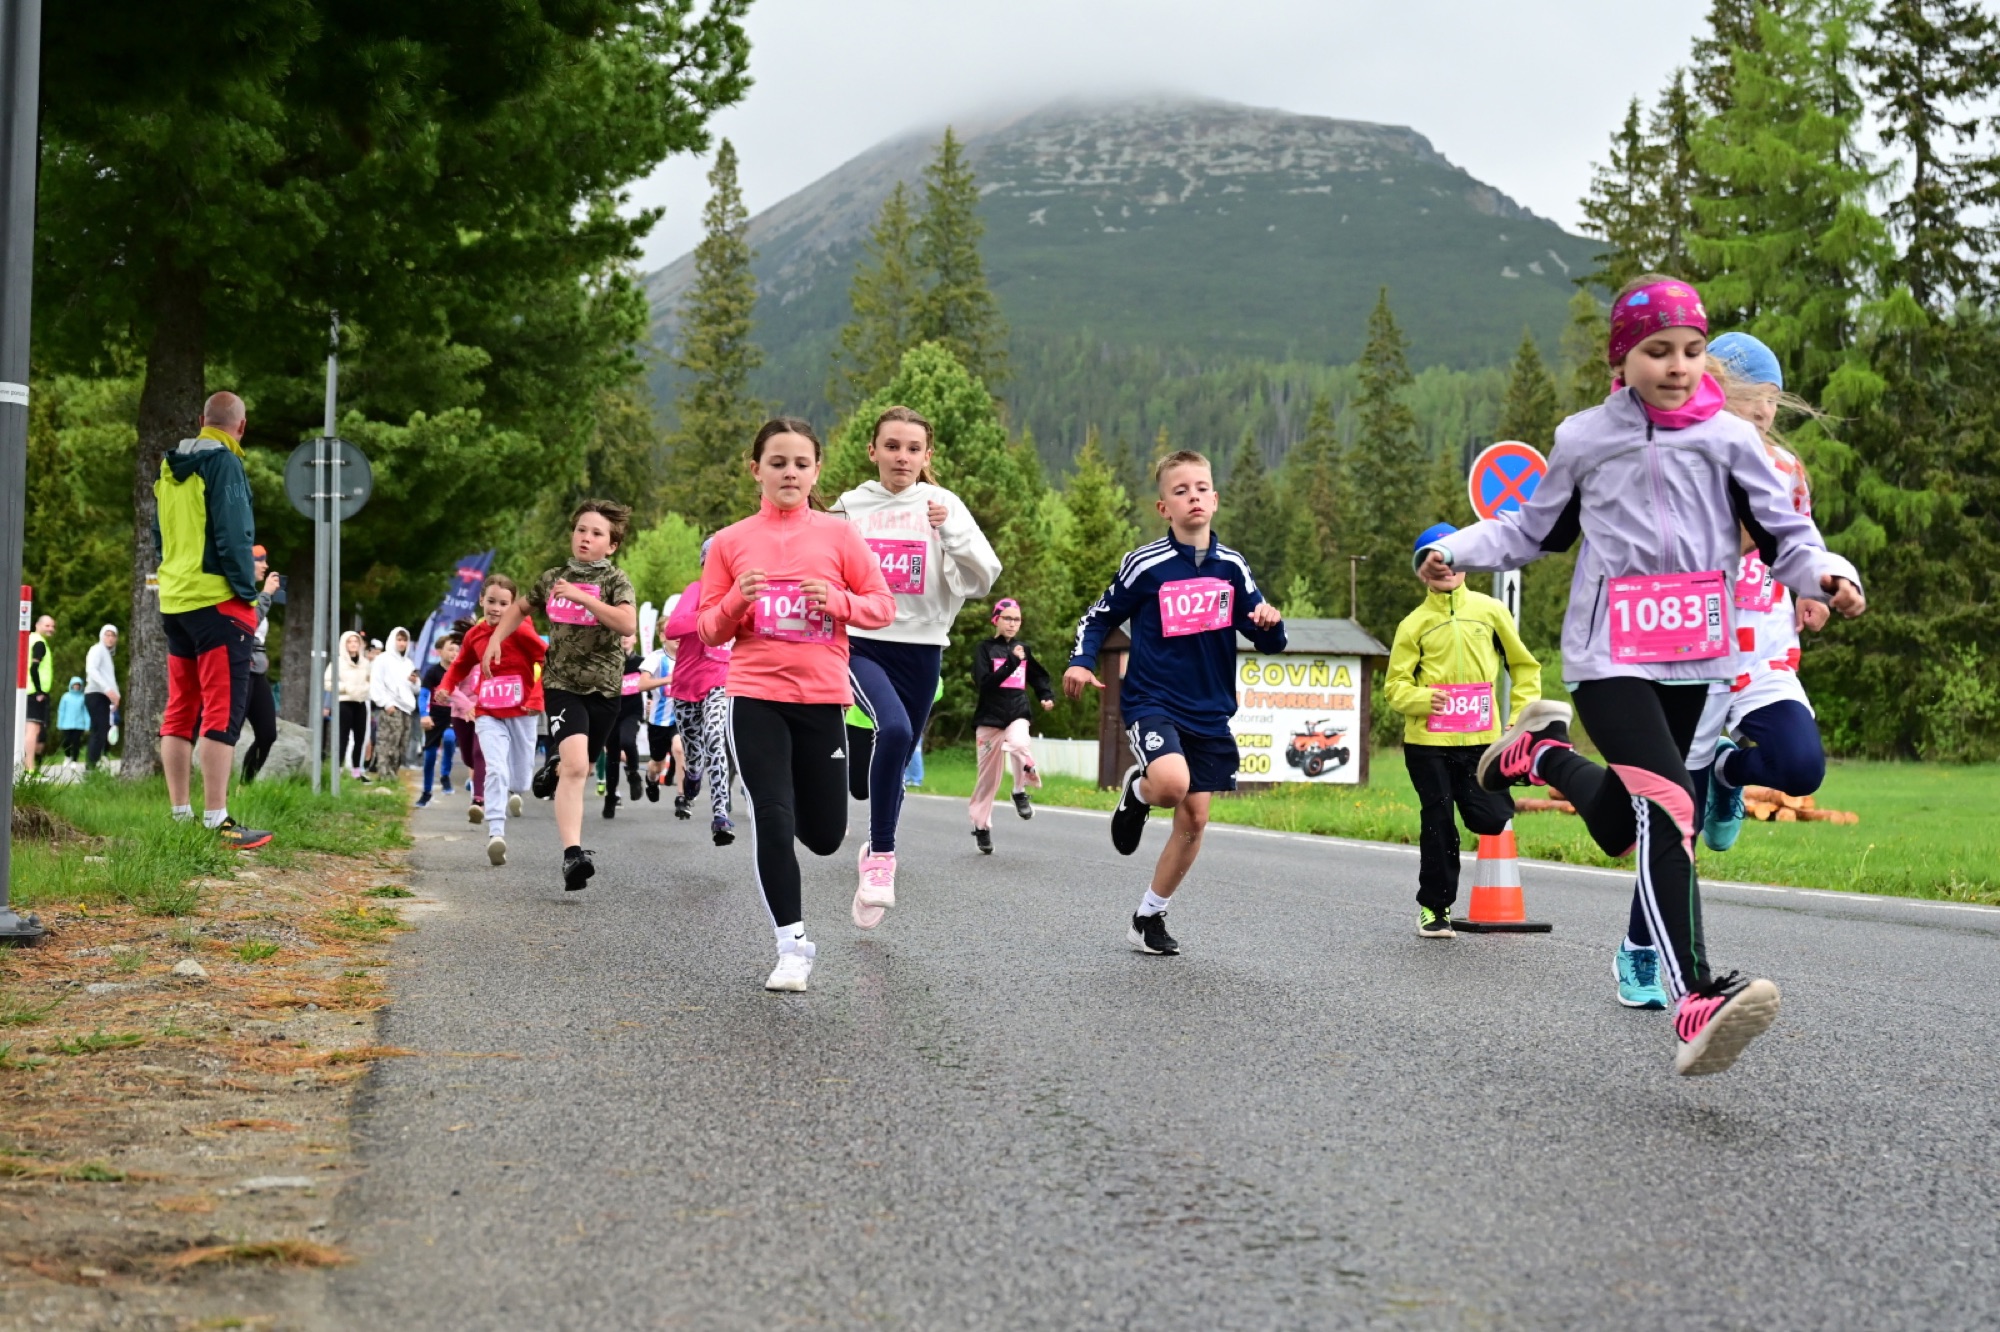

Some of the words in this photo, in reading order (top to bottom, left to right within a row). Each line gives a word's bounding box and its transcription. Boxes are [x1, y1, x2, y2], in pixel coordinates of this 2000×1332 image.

[760, 596, 821, 621] 1042
[1164, 591, 1217, 617] 1027
[1614, 595, 1703, 632] 1083
[1240, 658, 1352, 687] ČOVŇA
[481, 683, 513, 698] 1117
[1245, 688, 1355, 711] ŠTVORKOLIEK
[1236, 734, 1272, 748] OPEN
